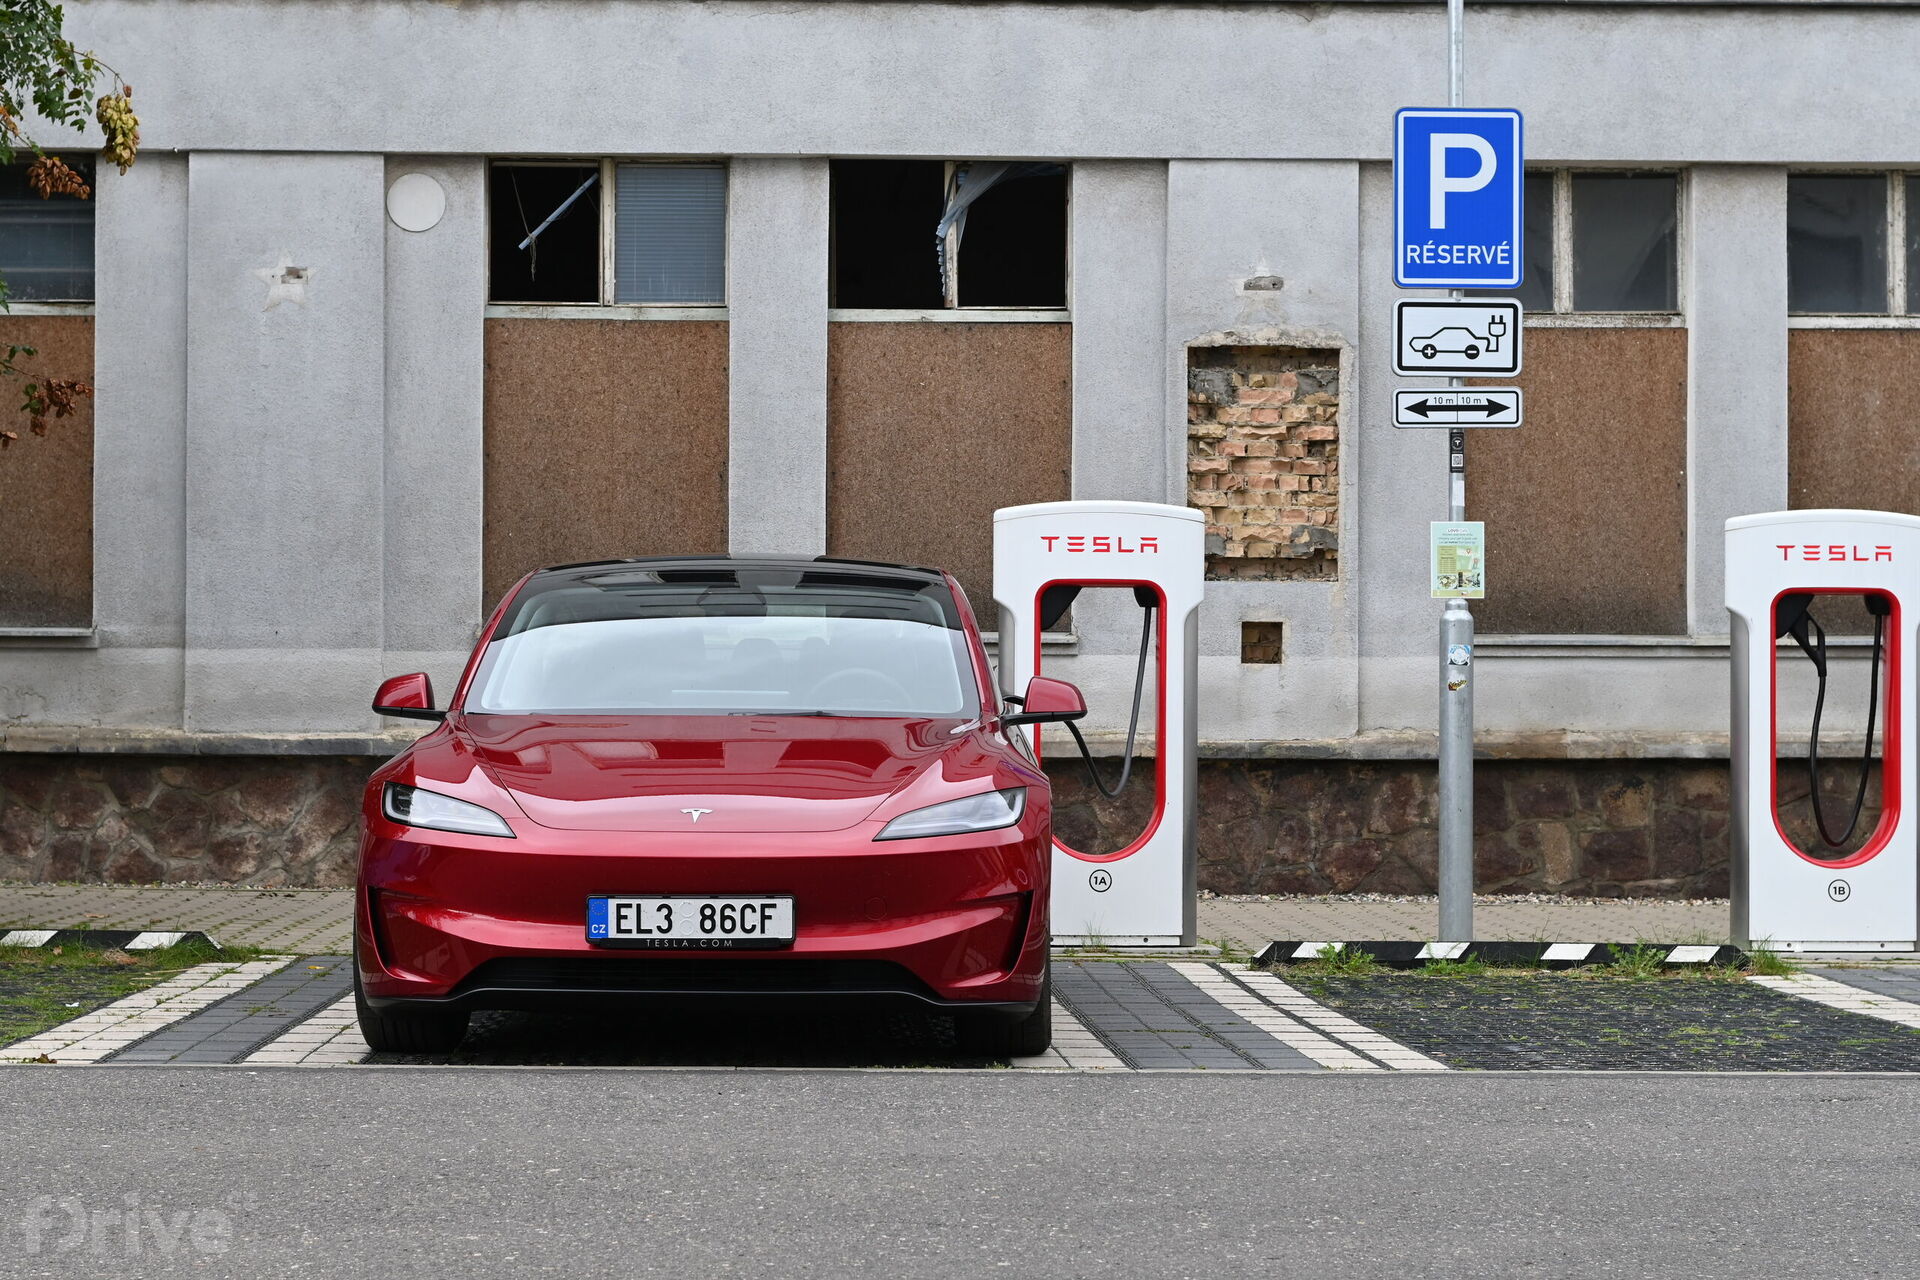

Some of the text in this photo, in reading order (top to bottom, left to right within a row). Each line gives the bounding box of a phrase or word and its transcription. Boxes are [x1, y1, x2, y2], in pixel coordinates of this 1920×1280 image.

[1430, 133, 1497, 229] P
[1406, 240, 1510, 265] RÉSERVÉ
[1433, 396, 1443, 404] 10
[1461, 396, 1471, 404] 10
[1040, 536, 1158, 553] TESLA
[1776, 545, 1892, 561] TESLA
[1094, 876, 1107, 885] 1A
[1833, 886, 1846, 895] 1B
[615, 903, 777, 934] EL3 86CF
[591, 924, 606, 934] CZ
[646, 939, 733, 947] TESLA.COM
